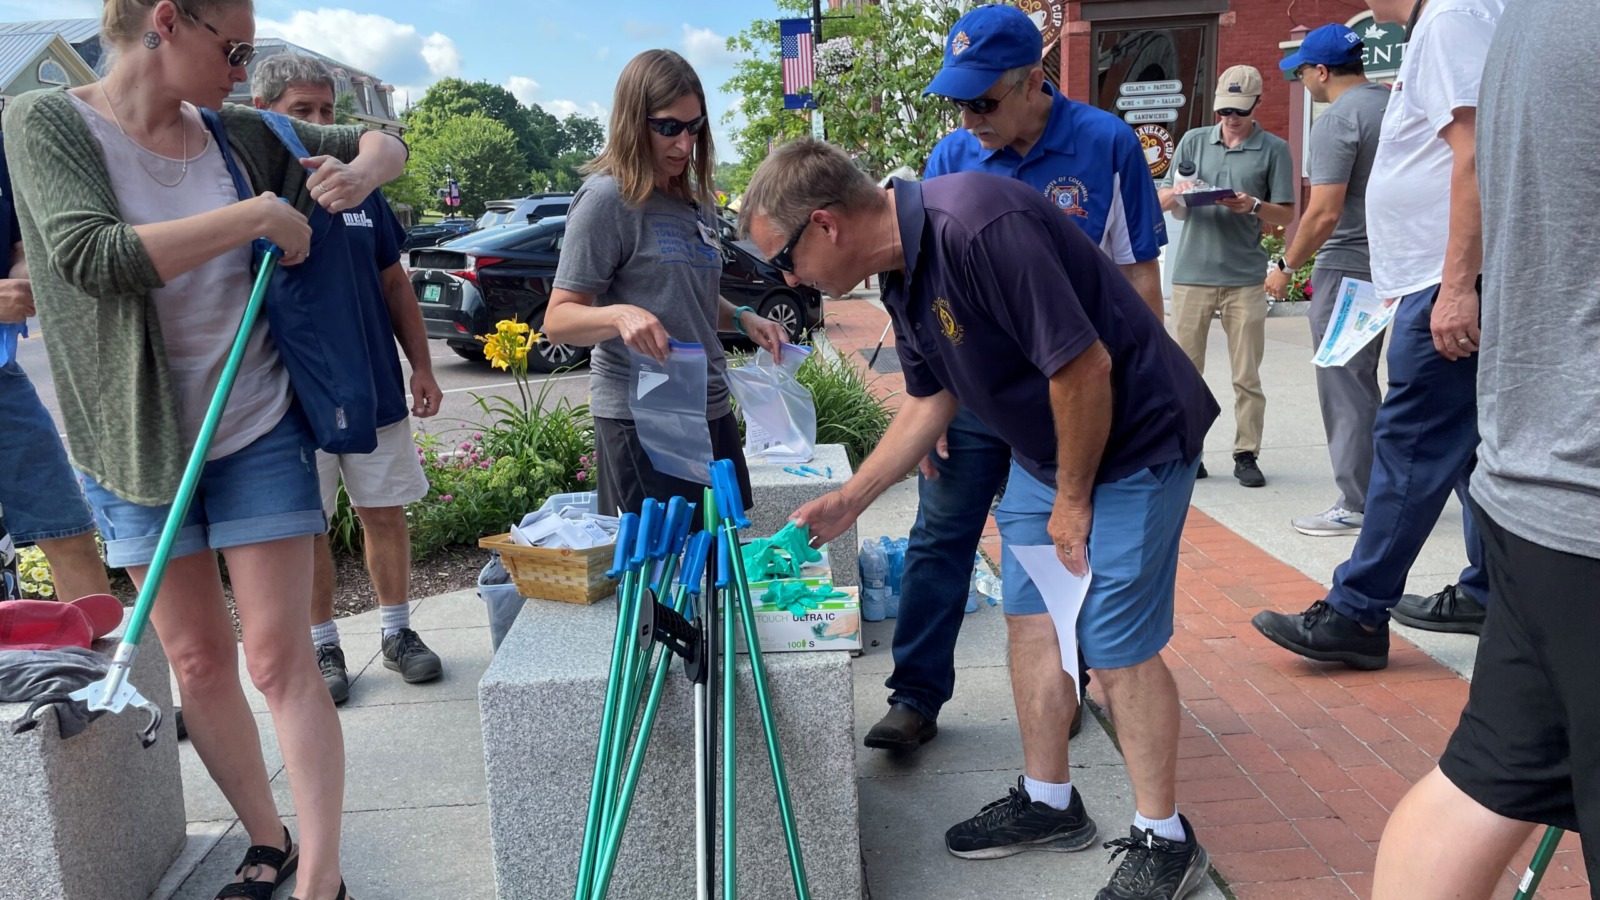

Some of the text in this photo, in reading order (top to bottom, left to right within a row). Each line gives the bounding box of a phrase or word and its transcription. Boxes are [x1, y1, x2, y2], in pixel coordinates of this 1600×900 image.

[1052, 4, 1062, 27] CUP
[1134, 112, 1169, 120] SANDWICHES
[1165, 141, 1173, 159] CUP
[825, 612, 835, 621] IC
[787, 641, 802, 649] 100
